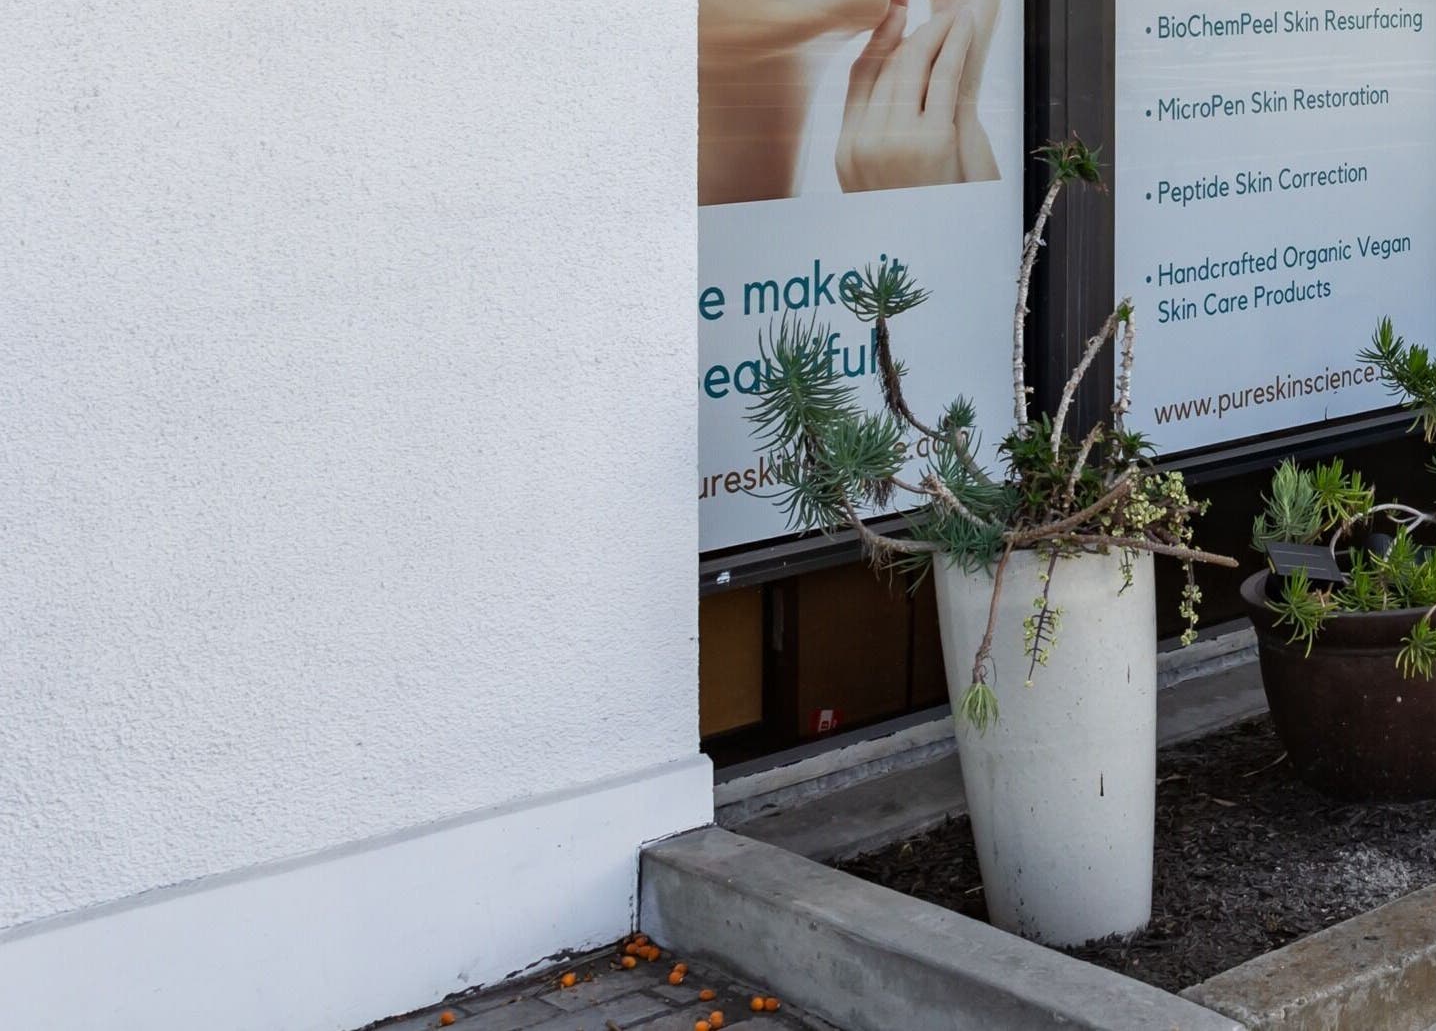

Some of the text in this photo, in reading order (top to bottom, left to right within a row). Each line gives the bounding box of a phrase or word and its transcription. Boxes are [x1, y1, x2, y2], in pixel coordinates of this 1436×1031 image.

[1158, 8, 1423, 39] BioChemPeel Skin Resurfacing
[1158, 84, 1389, 121] MicroPen Skin Restoration
[1158, 162, 1368, 207] Peptide Skin Correction
[1158, 234, 1411, 287] Handcrafted Organic Vegan
[698, 286, 726, 321] e
[744, 259, 863, 315] make
[1158, 278, 1331, 323] Skin Care Products
